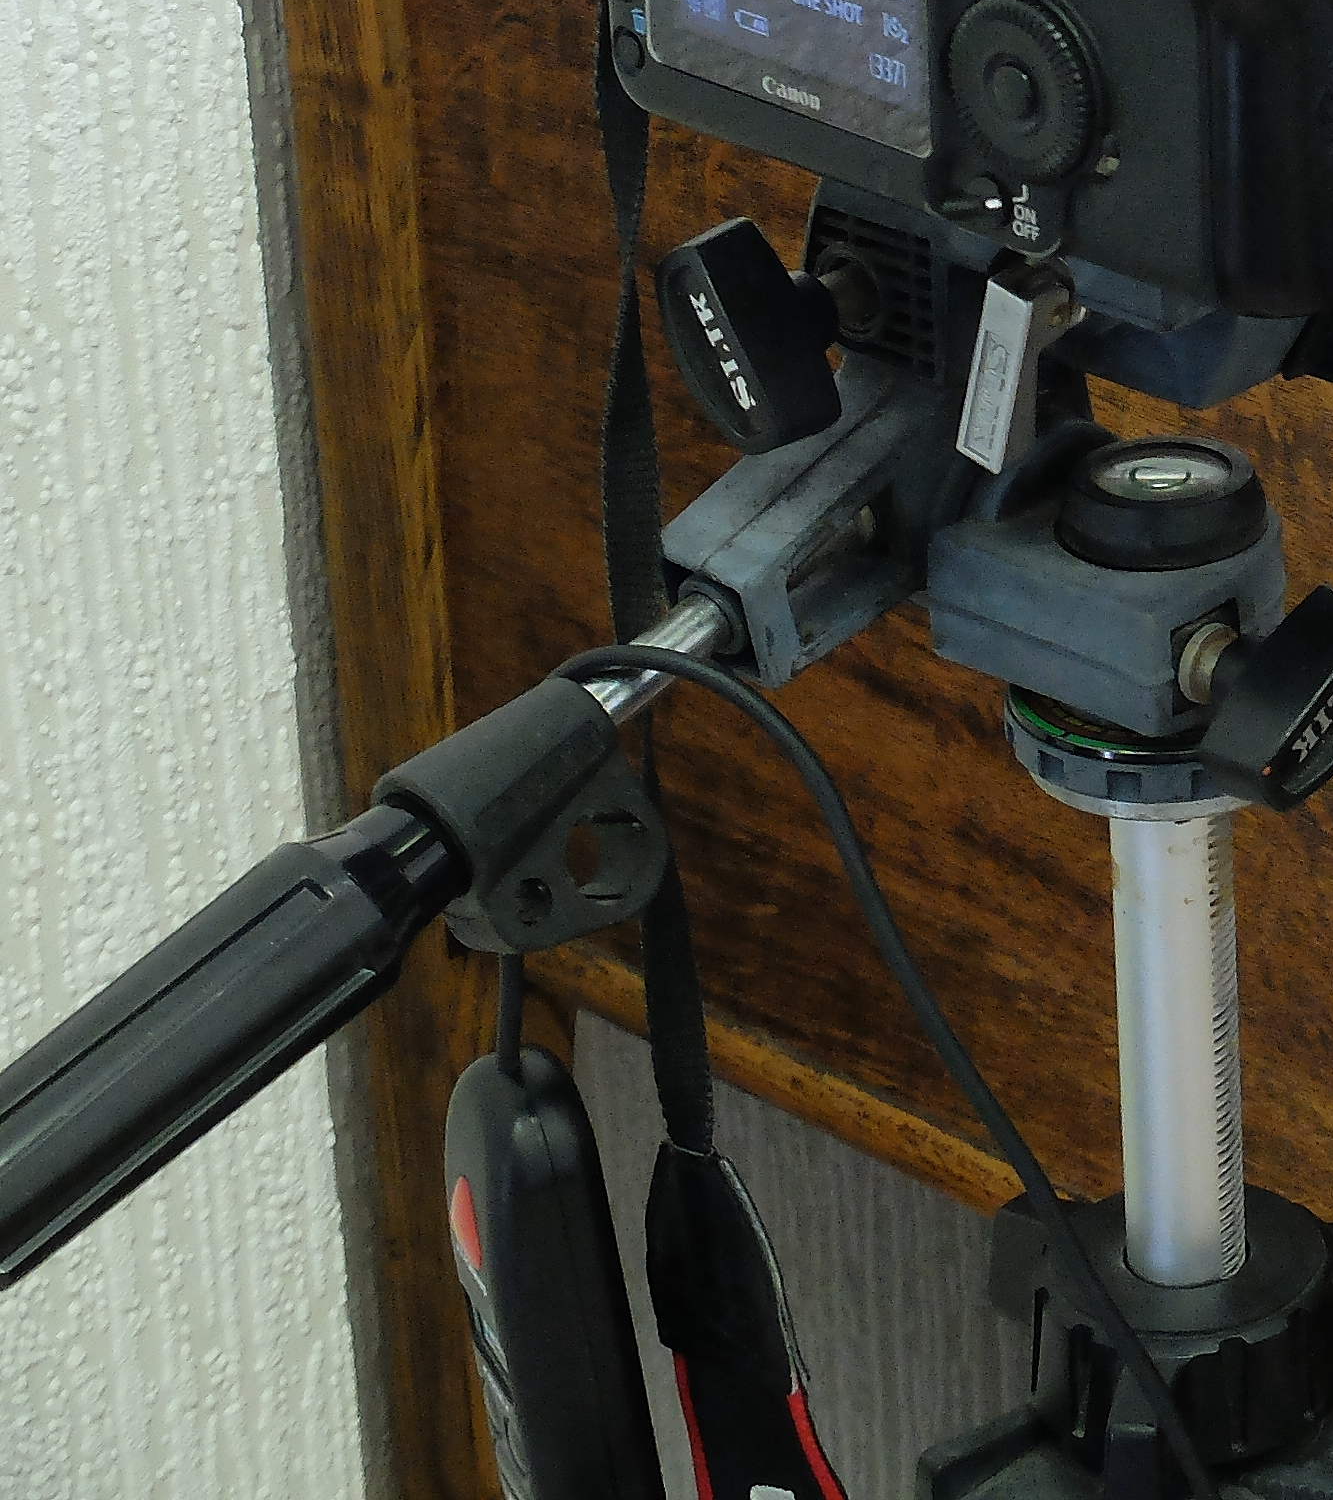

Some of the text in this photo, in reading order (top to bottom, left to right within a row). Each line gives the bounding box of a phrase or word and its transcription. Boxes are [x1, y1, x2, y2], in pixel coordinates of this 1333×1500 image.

[762, 75, 821, 112] Canon
[1013, 204, 1037, 226] ON
[1012, 220, 1041, 241] OFF
[689, 292, 757, 412] SLIK
